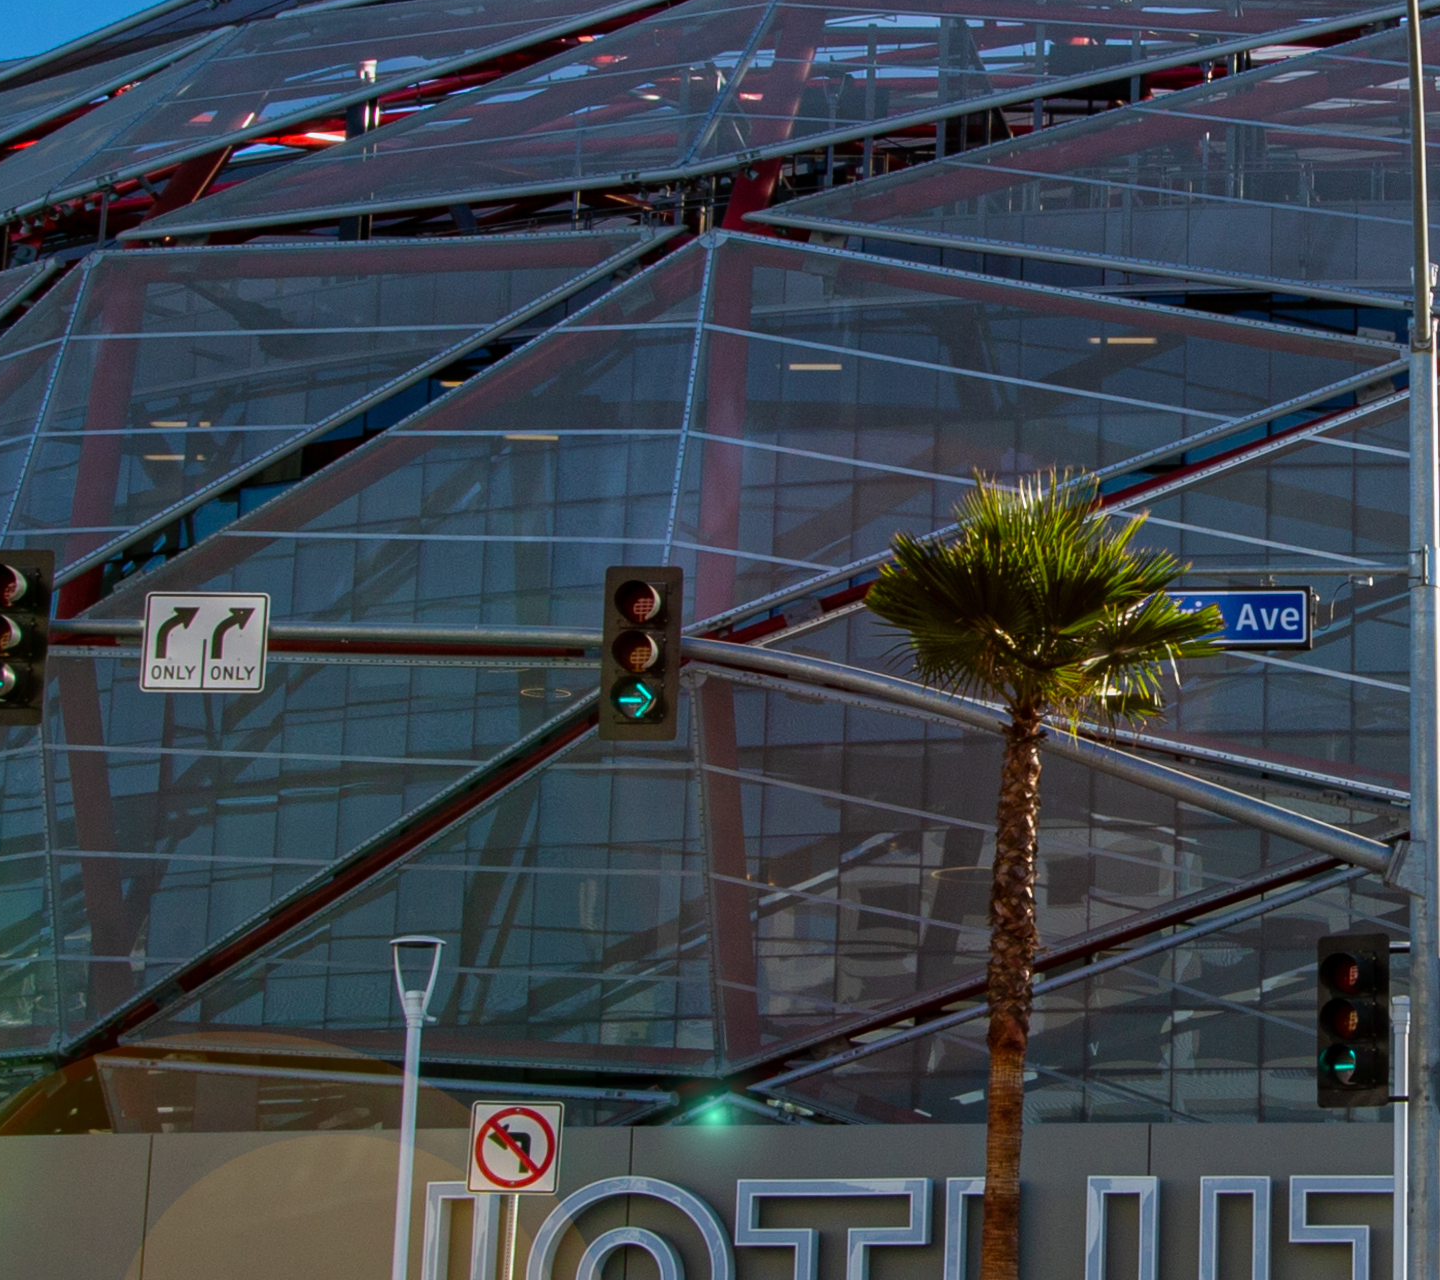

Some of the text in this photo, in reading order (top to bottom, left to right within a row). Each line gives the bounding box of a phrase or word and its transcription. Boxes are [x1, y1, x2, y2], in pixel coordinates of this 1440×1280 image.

[1235, 603, 1300, 631] Ave
[151, 665, 196, 680] ONLY
[210, 665, 255, 681] ONLY
